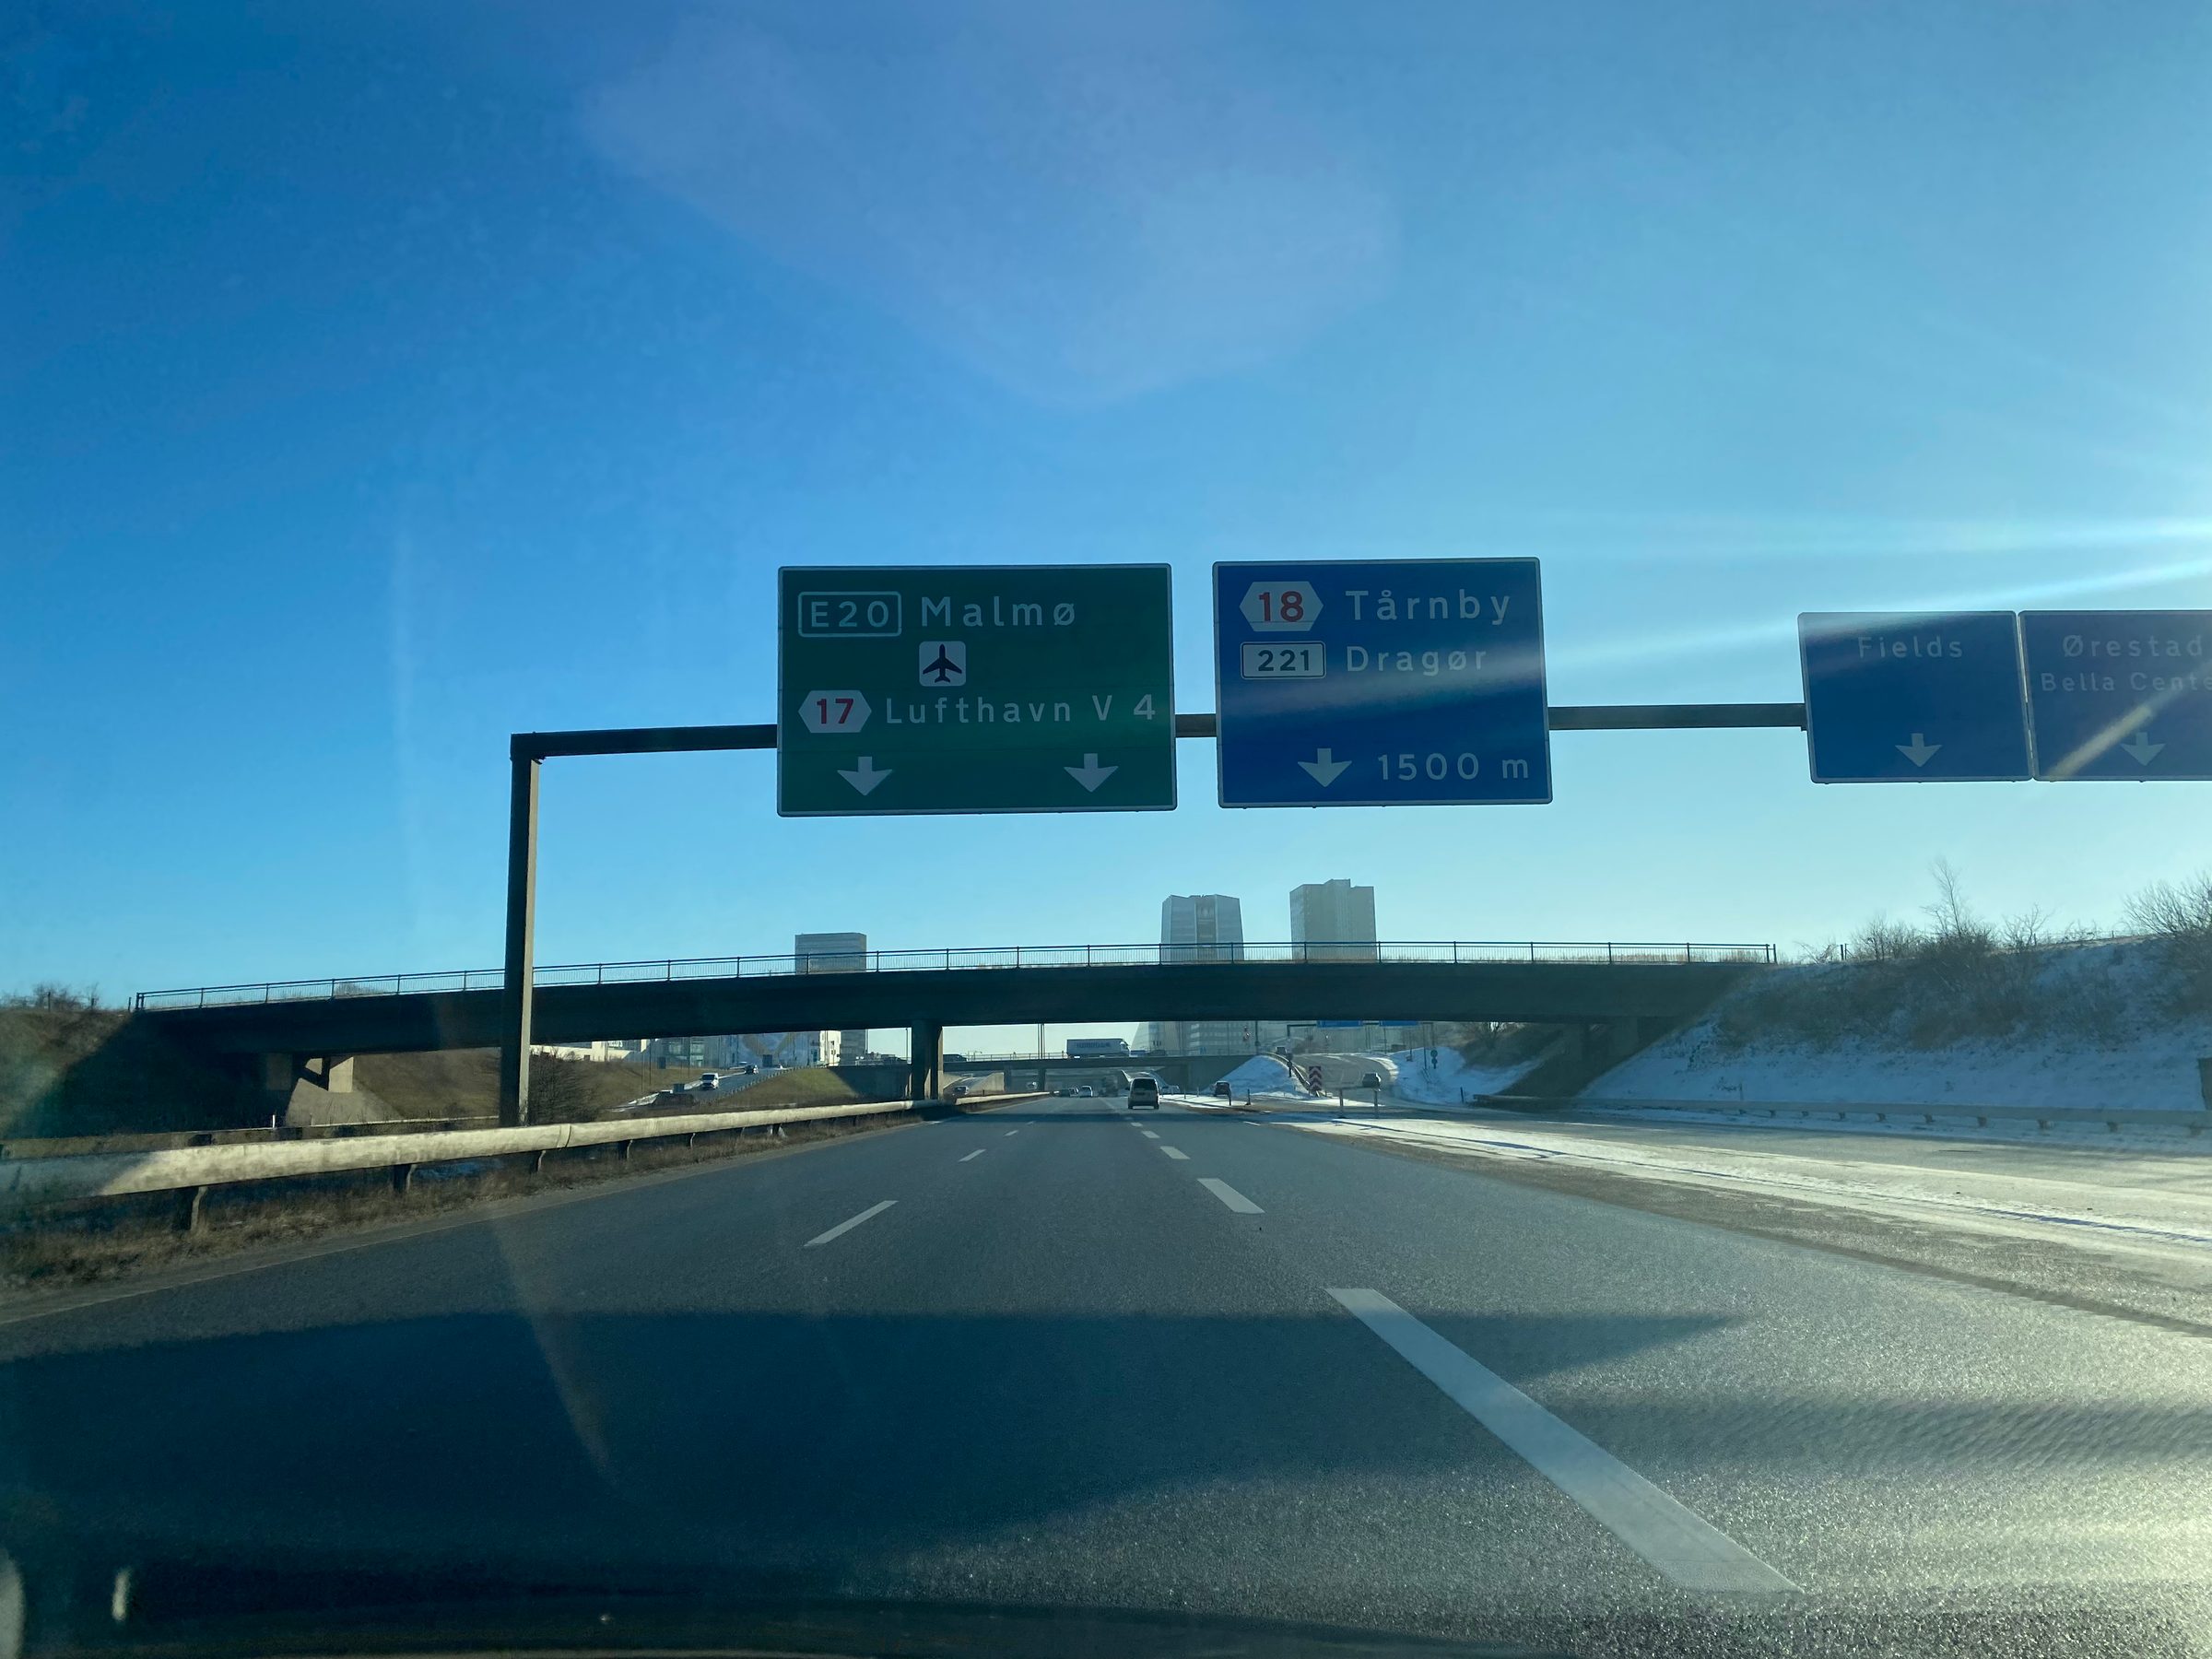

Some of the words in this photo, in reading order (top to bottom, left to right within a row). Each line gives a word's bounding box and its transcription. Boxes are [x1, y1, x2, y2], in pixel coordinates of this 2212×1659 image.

[810, 600, 889, 628] E20
[921, 595, 1077, 628] Malmø
[1258, 591, 1304, 623] 18
[1345, 588, 1510, 626] Tårnby
[1257, 649, 1311, 672] 221
[1346, 645, 1487, 677] Dragør
[1857, 635, 1963, 659] Fields
[2062, 634, 2203, 658] Ørestad
[2041, 672, 2115, 691] Bella
[816, 698, 854, 724] 17
[886, 696, 1071, 724] Lufthavn
[1091, 694, 1112, 721] V
[1133, 693, 1156, 721] 4
[1377, 752, 1479, 782] 1500
[1501, 758, 1529, 780] m
